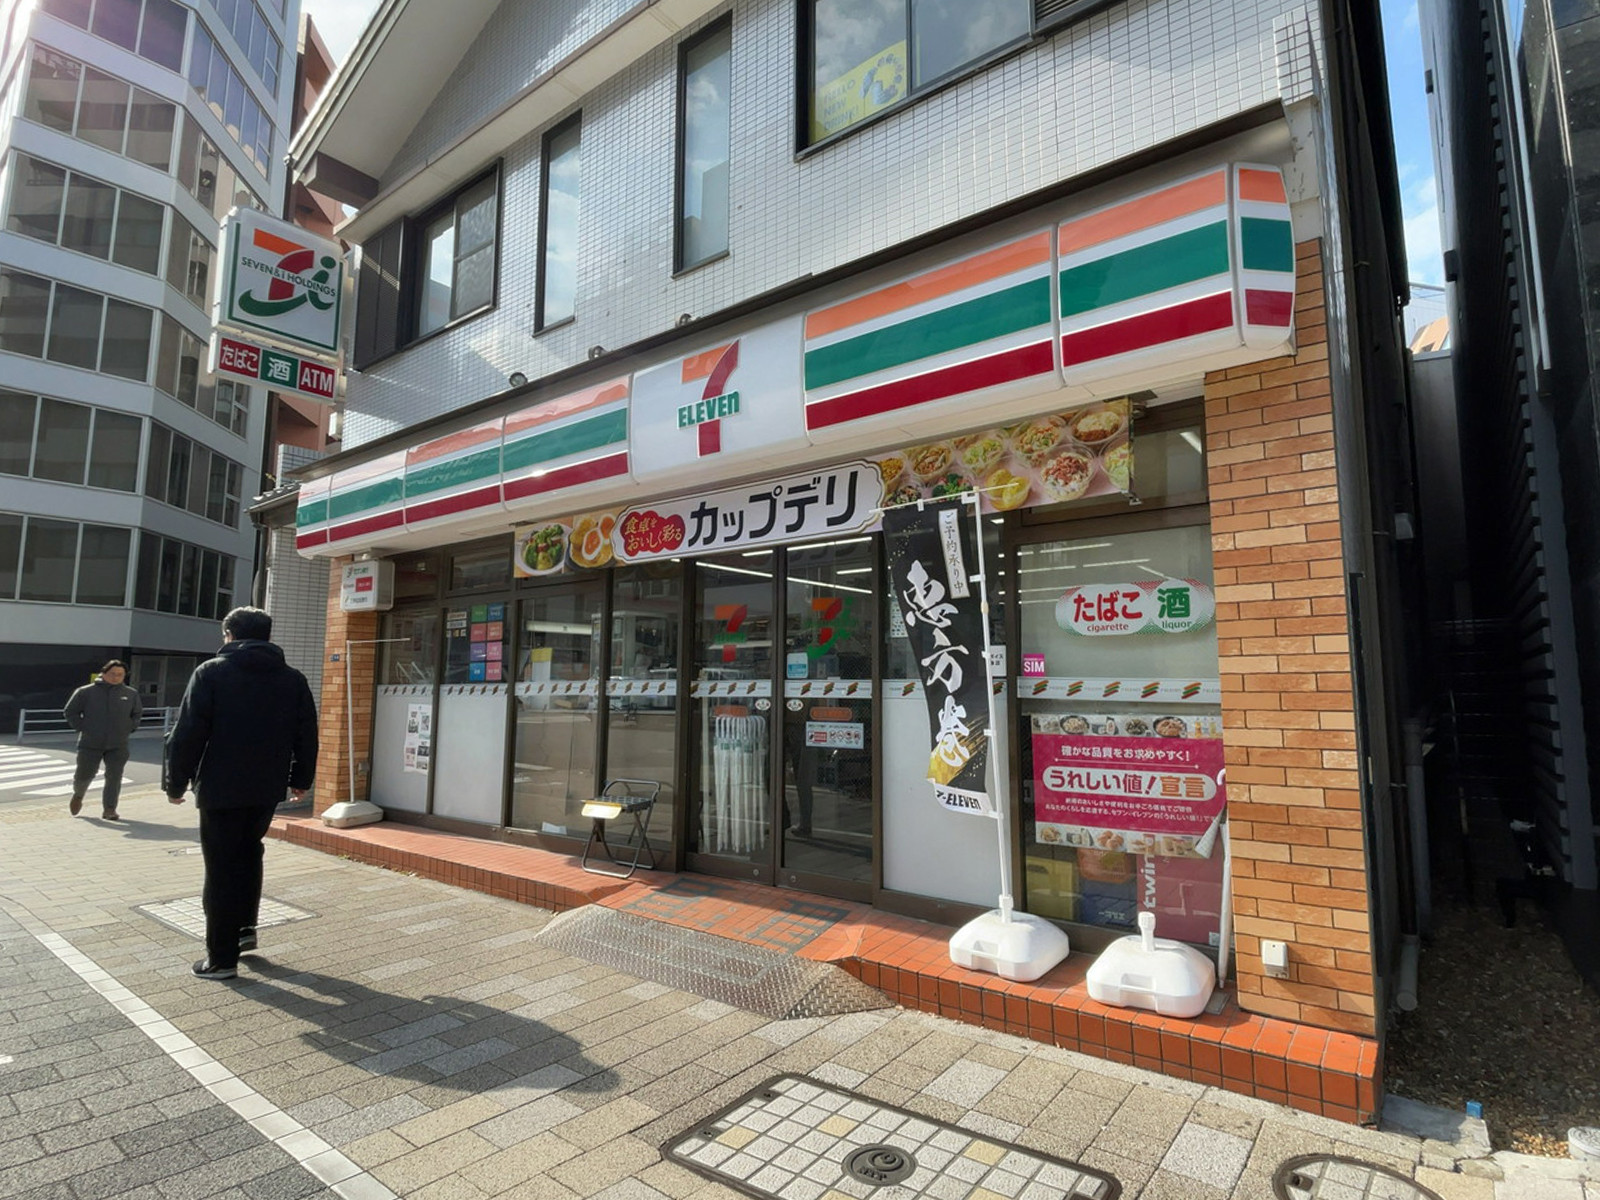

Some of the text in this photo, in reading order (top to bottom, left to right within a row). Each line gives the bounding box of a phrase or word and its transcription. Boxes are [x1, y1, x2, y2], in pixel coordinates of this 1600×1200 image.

[287, 274, 336, 296] HOLDINGS
[220, 343, 333, 393] たばこ 酒 ATM
[687, 470, 859, 548] カップデリ
[1073, 587, 1191, 623] たばこ 酒
[1086, 620, 1192, 633] cigarette liquor
[903, 559, 970, 768] 恵方巻
[1023, 660, 1045, 673] SIM
